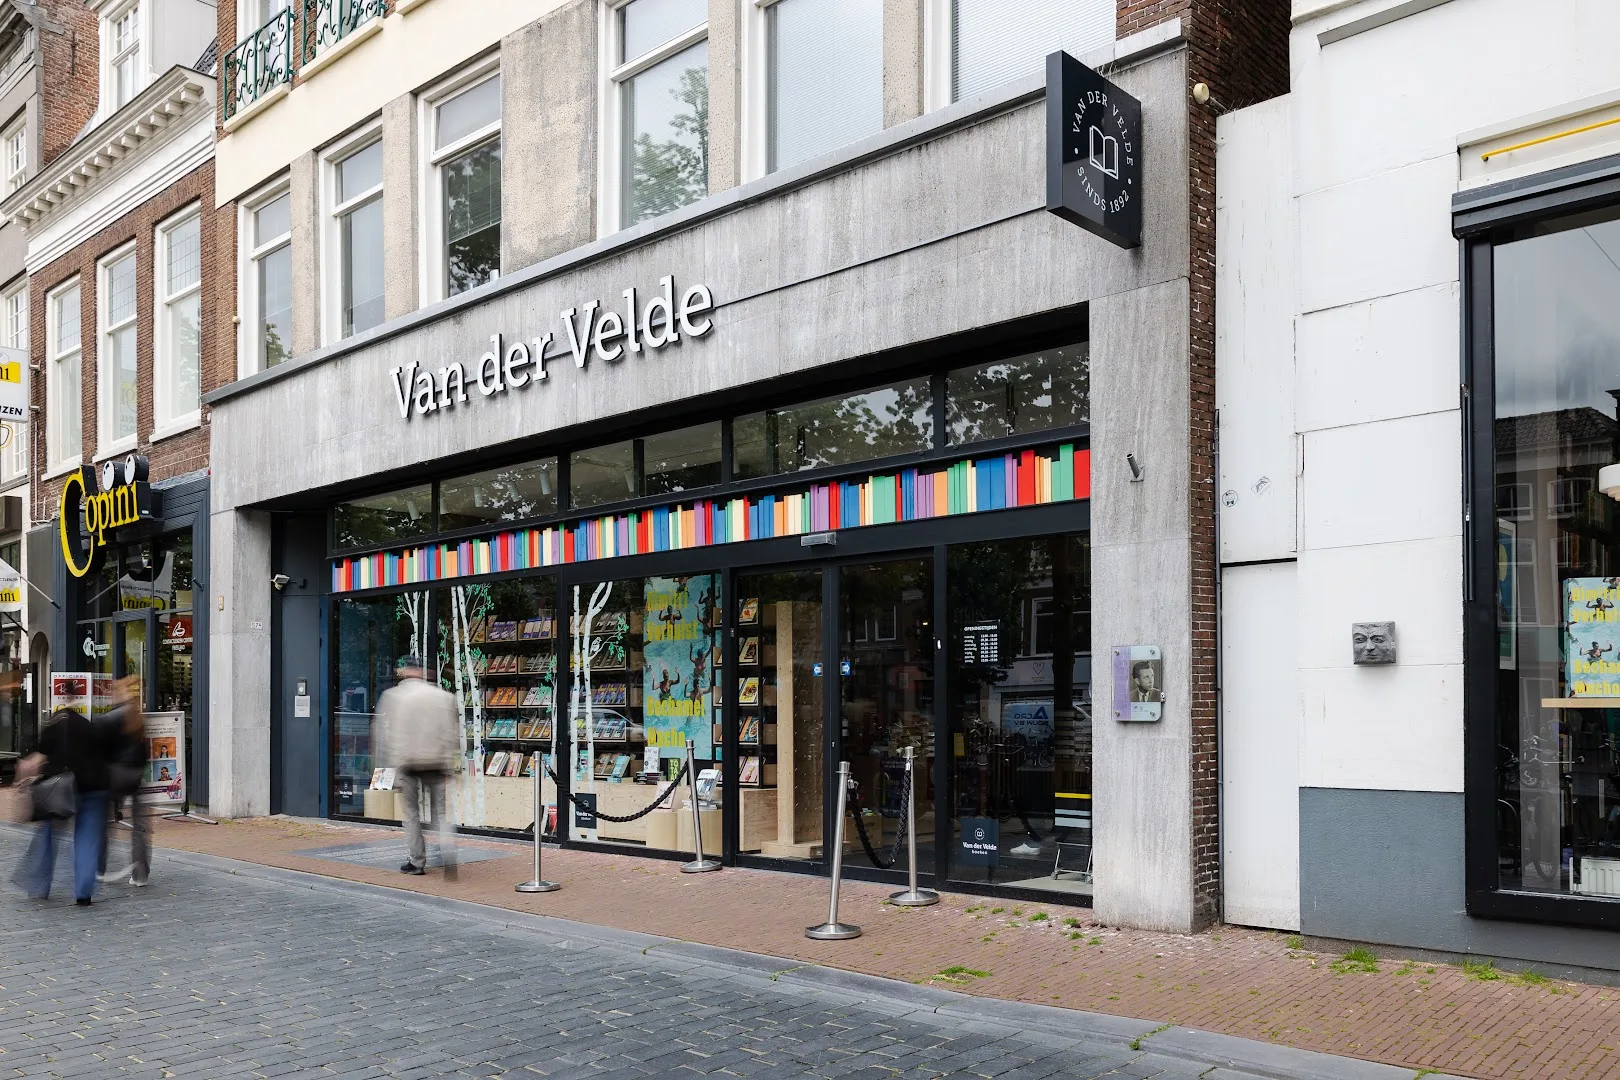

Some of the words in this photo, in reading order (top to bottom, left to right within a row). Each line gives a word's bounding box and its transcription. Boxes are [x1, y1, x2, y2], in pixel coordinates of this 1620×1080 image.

[1072, 97, 1087, 133] VAN
[1087, 90, 1109, 107] DER
[1111, 104, 1134, 166] VELDE
[1077, 166, 1107, 212] SINDS
[1109, 189, 1130, 213] 1892
[389, 360, 467, 419] Van
[476, 332, 554, 396] der
[560, 274, 716, 369] Velde
[0, 405, 23, 416] ZEN
[60, 460, 140, 577] Copini
[647, 586, 688, 611] Dimitri
[1571, 608, 1620, 622] Verhul
[647, 619, 698, 641] Verhulst
[1575, 680, 1620, 695] Mucho
[647, 695, 705, 717] Bechamel
[647, 726, 686, 748] Mucho
[962, 841, 973, 849] Van
